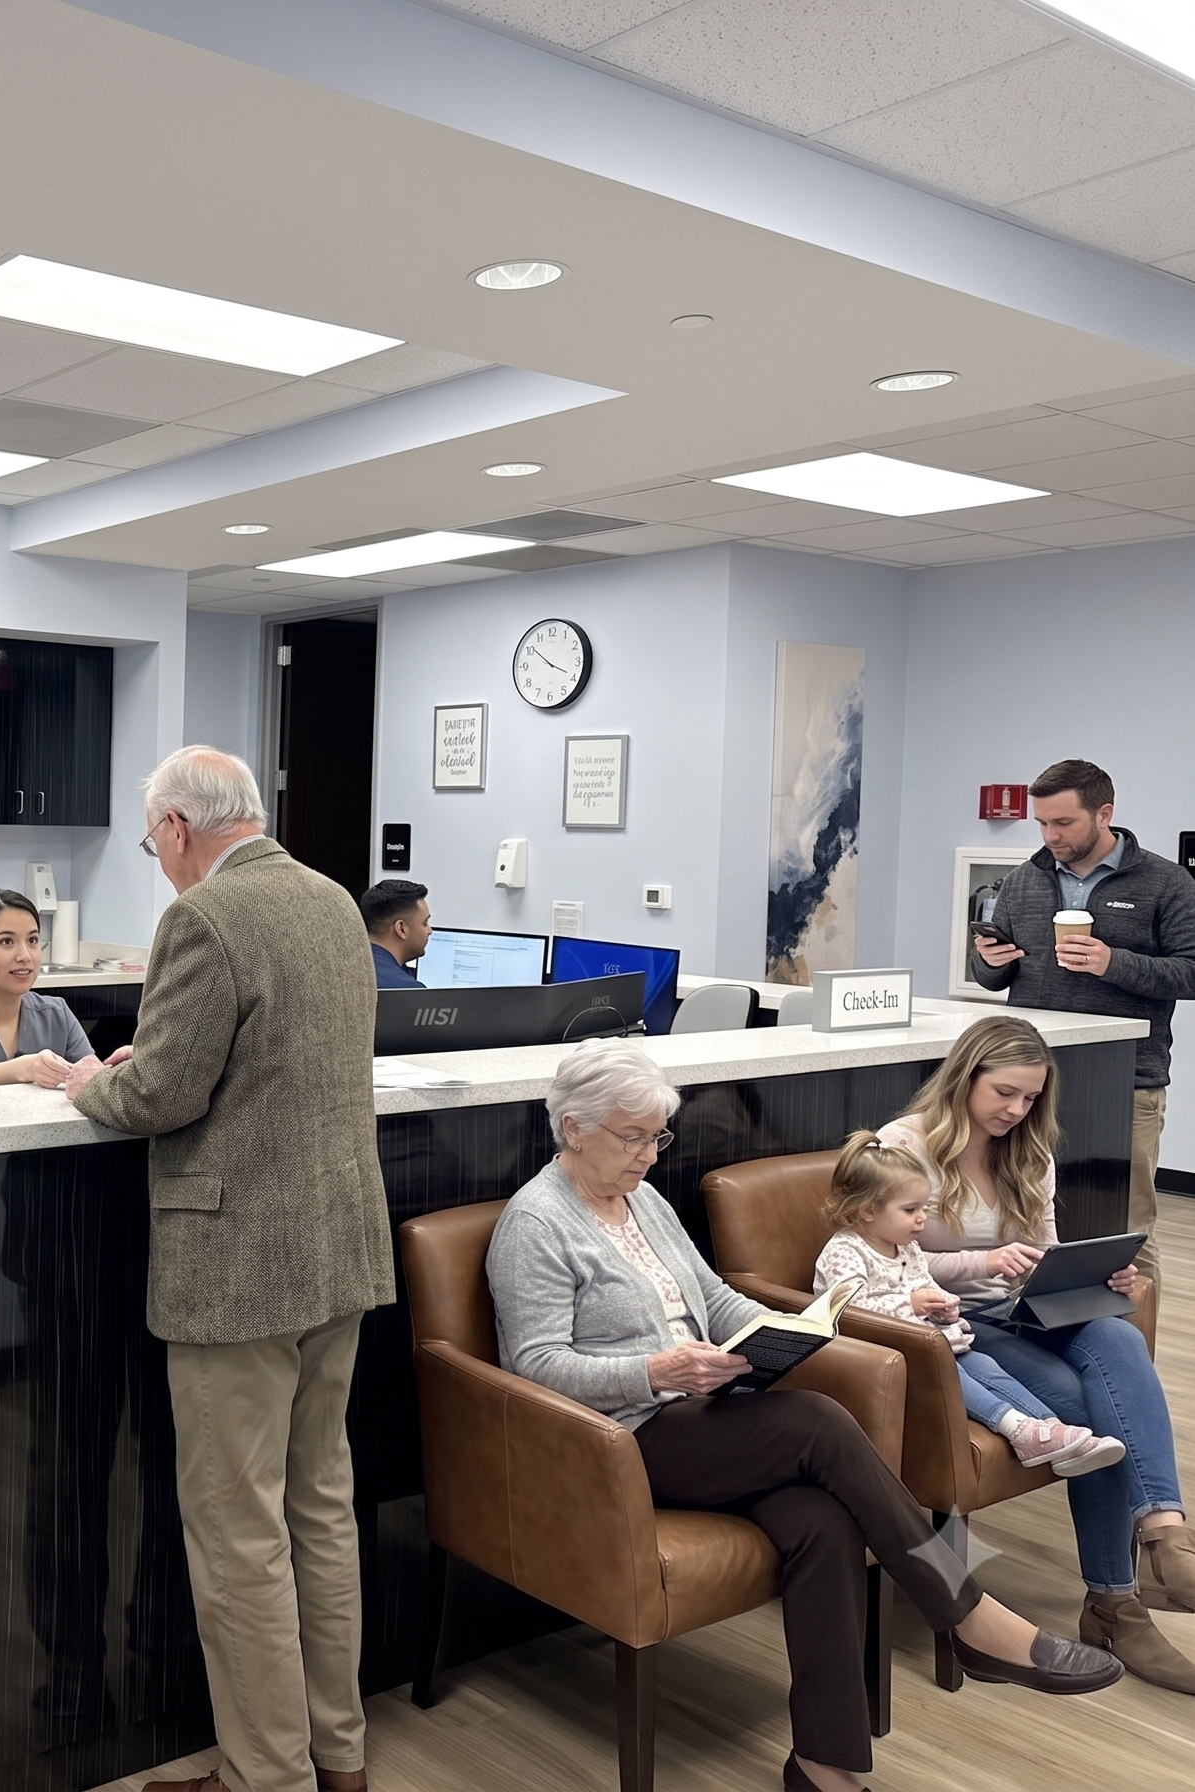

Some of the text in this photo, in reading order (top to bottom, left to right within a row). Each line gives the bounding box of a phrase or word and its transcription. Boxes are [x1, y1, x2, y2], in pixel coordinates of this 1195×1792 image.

[548, 626, 557, 637] 12
[526, 645, 535, 656] 10
[571, 639, 579, 651] 2
[522, 661, 529, 671] 9
[574, 656, 581, 667] 3
[525, 677, 532, 688] 8
[570, 673, 577, 682] 4
[535, 687, 542, 698] 7
[560, 685, 567, 696] 5
[547, 691, 554, 702] 6
